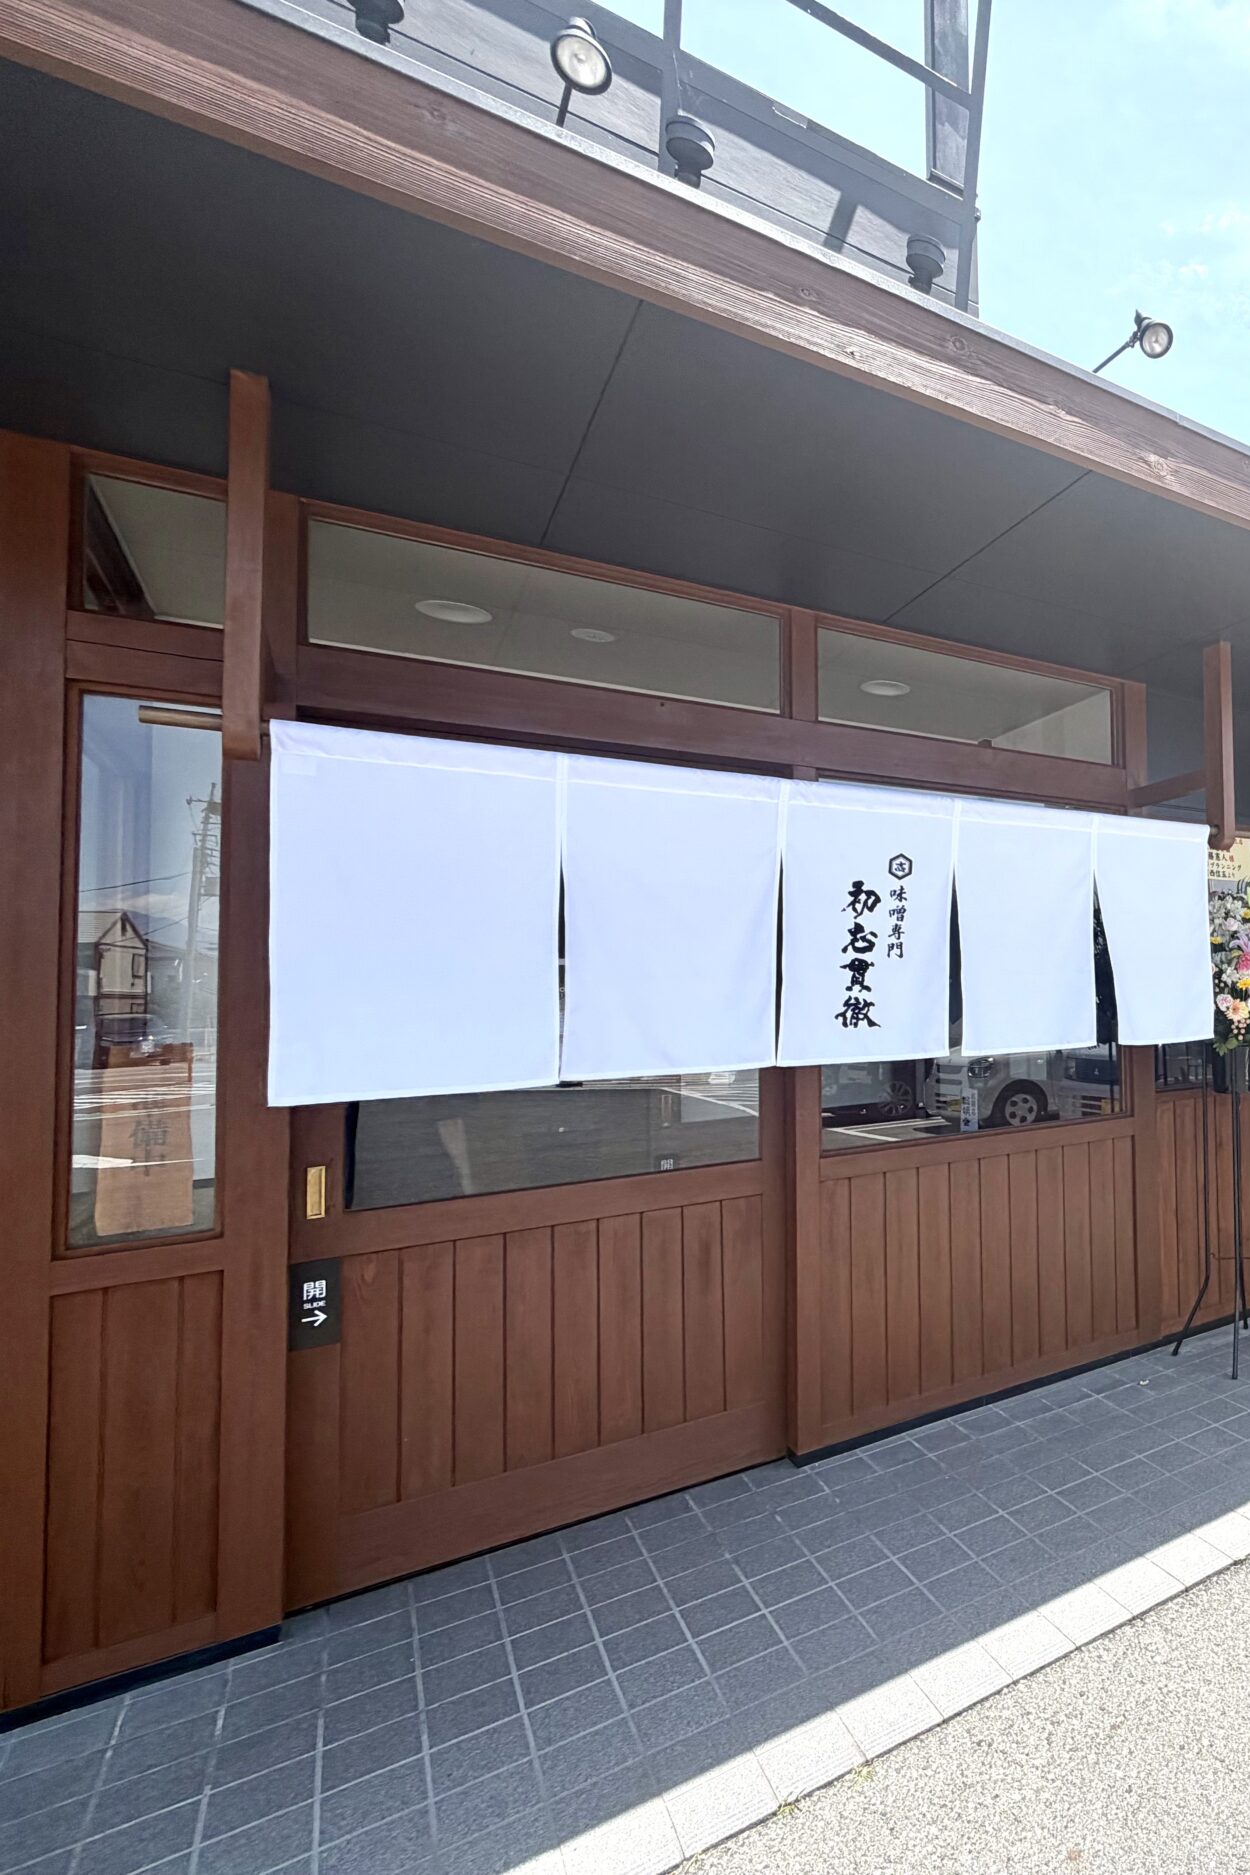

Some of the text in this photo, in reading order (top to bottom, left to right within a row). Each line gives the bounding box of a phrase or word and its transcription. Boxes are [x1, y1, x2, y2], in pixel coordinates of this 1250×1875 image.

[887, 885, 908, 958] 味噌専門
[834, 880, 882, 1028] 初志貫徹
[303, 1280, 327, 1300] 開
[303, 1300, 327, 1309] SLIDE
